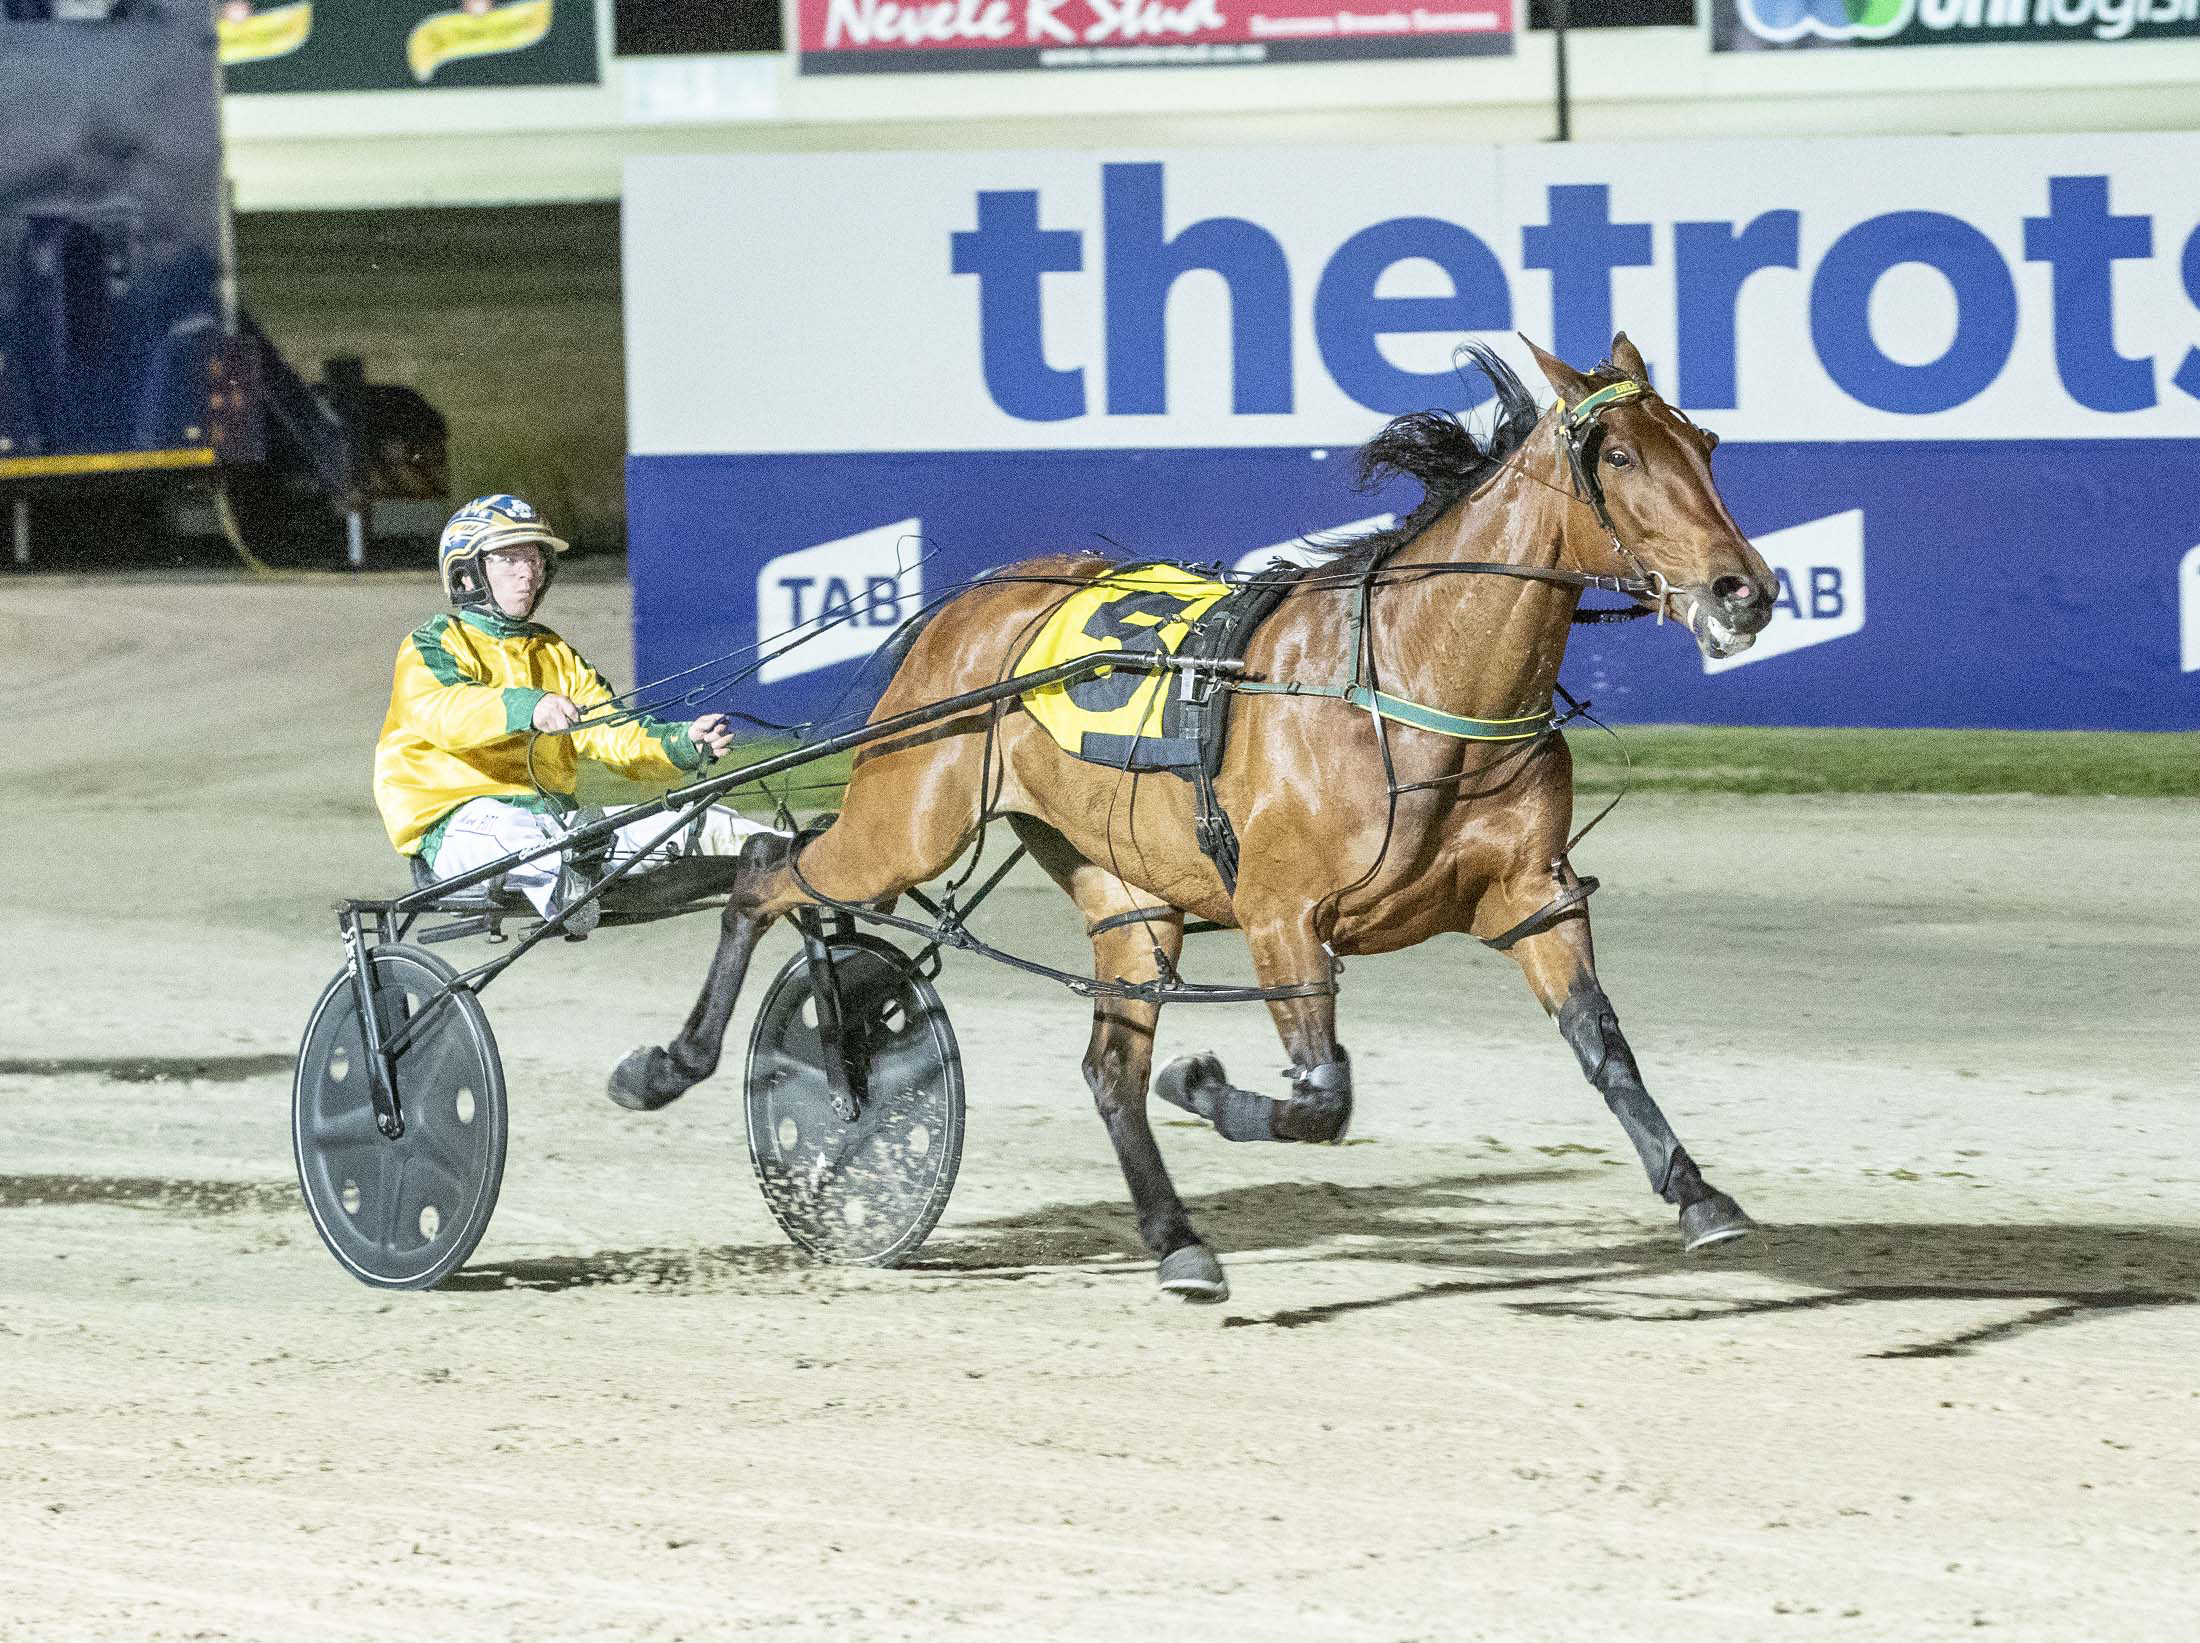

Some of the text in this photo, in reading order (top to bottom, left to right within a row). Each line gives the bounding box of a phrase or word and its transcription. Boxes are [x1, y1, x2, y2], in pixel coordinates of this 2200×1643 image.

[950, 160, 2200, 423] thetrot
[777, 575, 902, 628] TAB
[1770, 566, 1844, 619] AB
